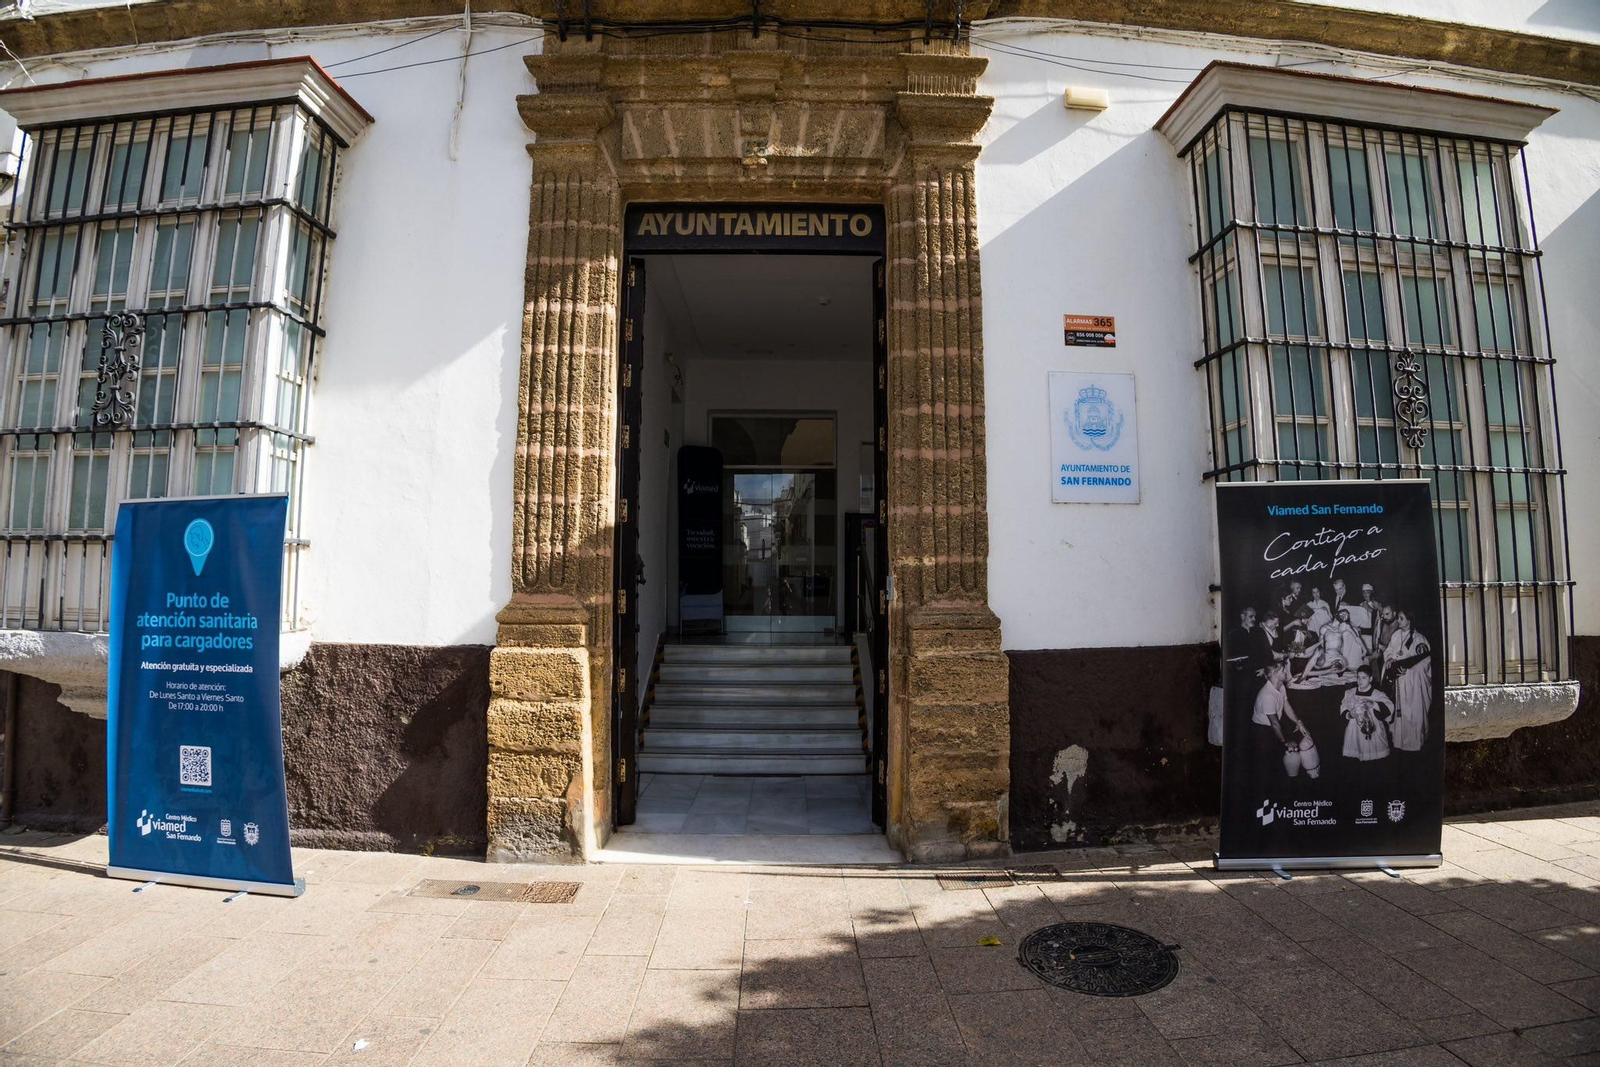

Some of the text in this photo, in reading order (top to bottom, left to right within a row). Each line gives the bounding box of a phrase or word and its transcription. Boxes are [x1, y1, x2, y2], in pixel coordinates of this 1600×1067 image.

[637, 213, 872, 236] AYUNTAMIENTO
[1093, 317, 1112, 327] 365
[1061, 464, 1119, 472] AYUNTAMIENTO
[1061, 477, 1131, 486] SAN FERNANDO
[1267, 503, 1383, 516] Viamed San Fernando
[1264, 526, 1382, 561] Contigo a
[1270, 548, 1386, 578] cada paso
[166, 592, 229, 608] Punto de
[137, 611, 258, 628] atención sanitaria
[141, 632, 253, 652] para cargadores
[141, 662, 253, 673] Atención gratuita y especializada
[166, 681, 226, 691] Horario de atención:
[160, 691, 176, 700] Lunes
[177, 692, 195, 700] Santo
[202, 693, 224, 701] Viernes
[226, 694, 244, 702] Santo
[168, 702, 177, 710] De
[178, 702, 194, 710] 17:00
[200, 703, 217, 711] 20:00
[219, 704, 223, 712] h
[166, 813, 180, 821] Centro
[1276, 806, 1318, 818] viamed
[152, 819, 186, 832] viamed
[1294, 818, 1336, 826] San Fernando
[177, 833, 201, 842] Fernando
